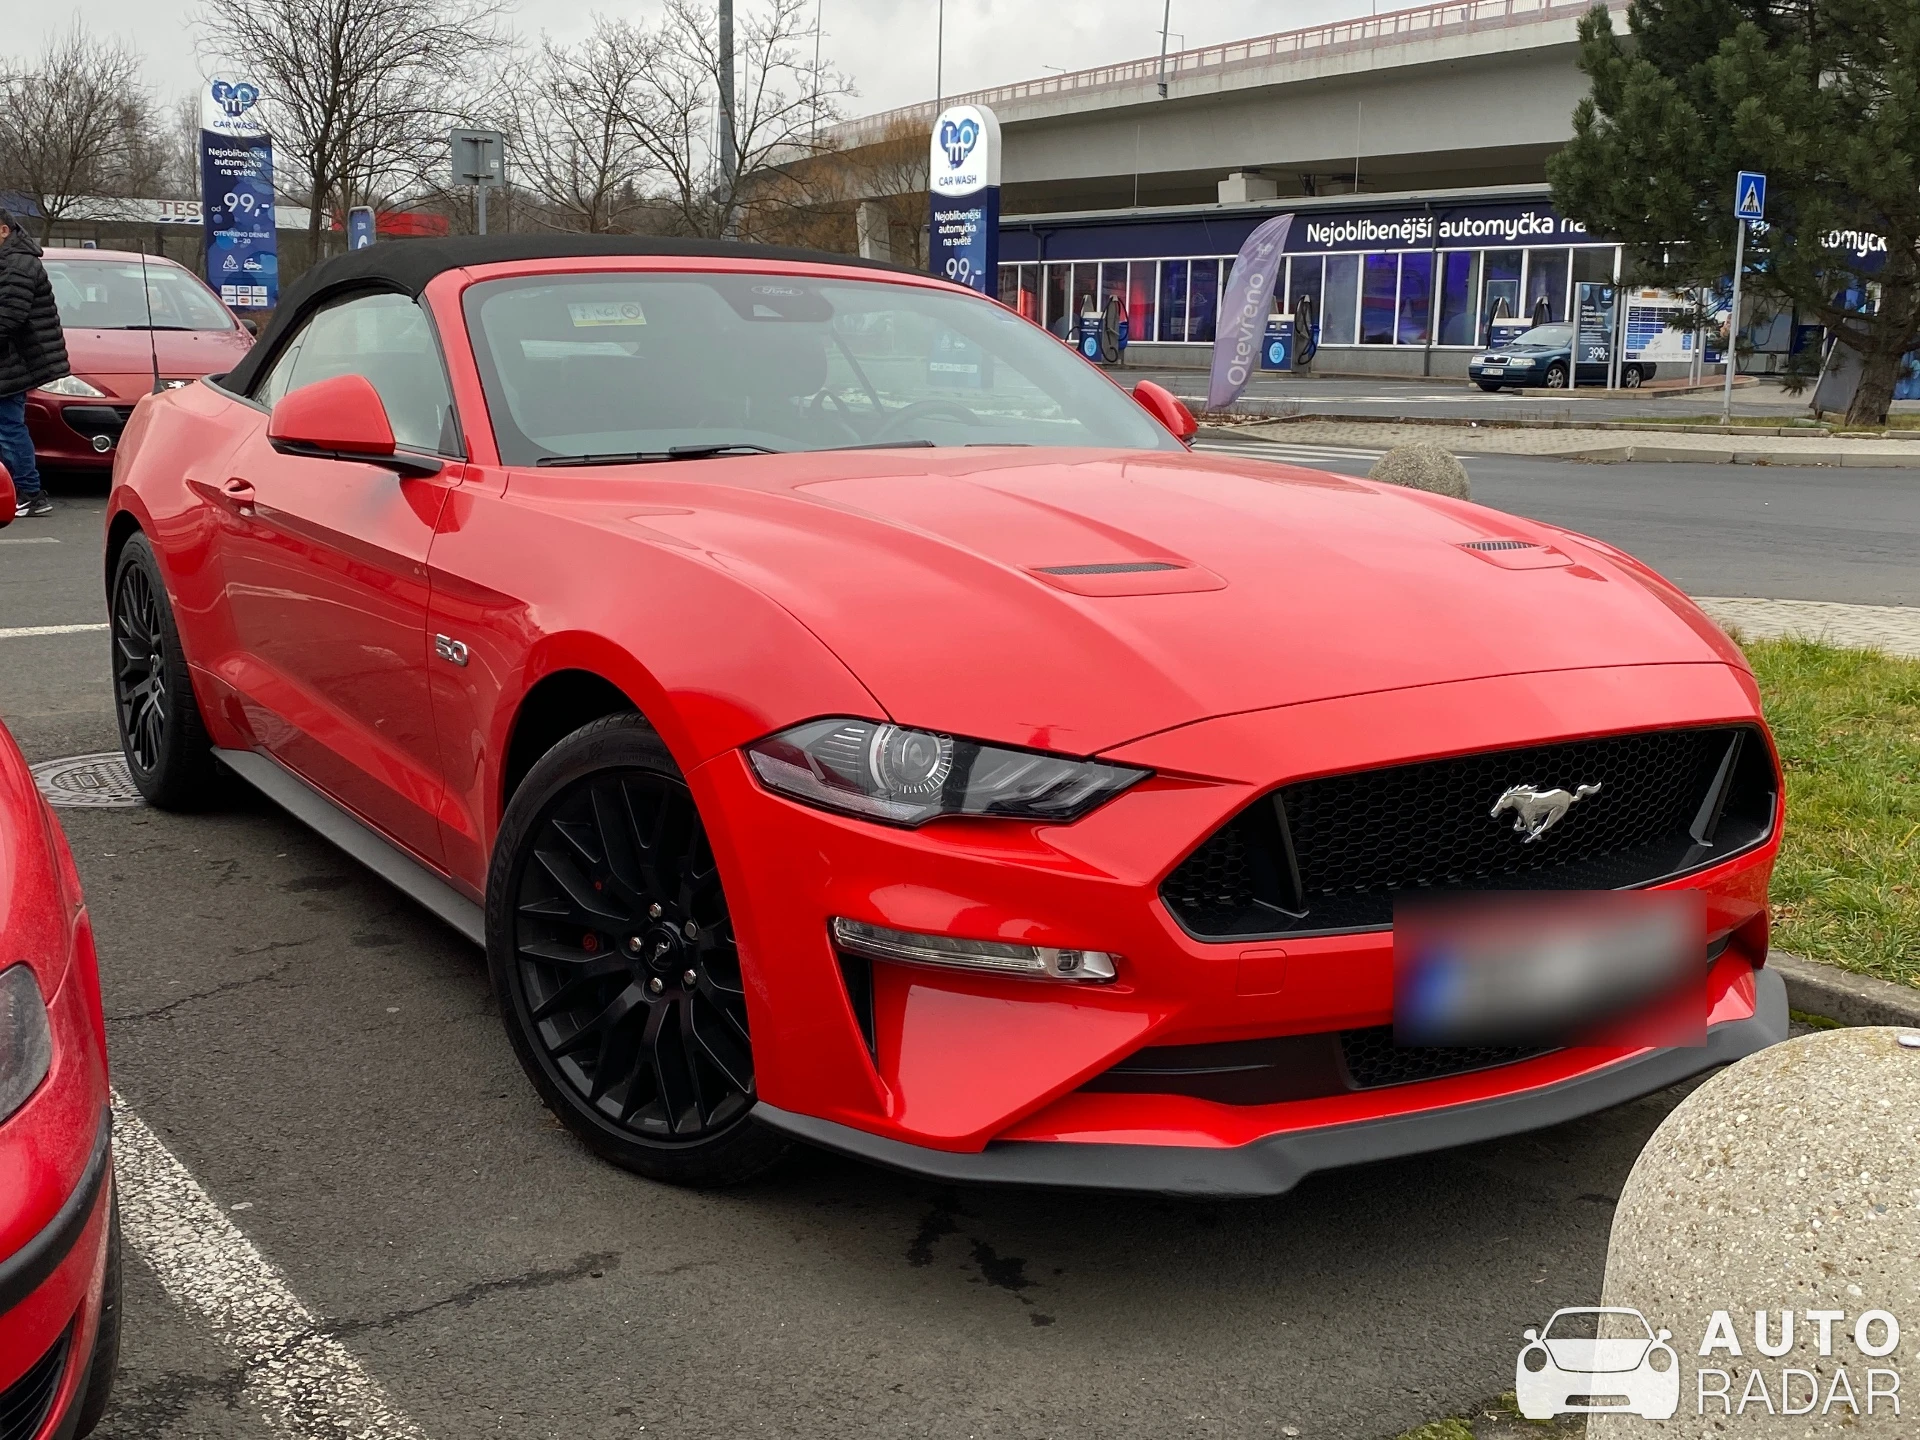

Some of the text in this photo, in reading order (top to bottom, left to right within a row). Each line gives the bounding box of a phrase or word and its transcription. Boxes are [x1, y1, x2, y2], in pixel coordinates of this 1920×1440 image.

[213, 120, 231, 128] CAR
[220, 168, 232, 176] na
[939, 174, 977, 187] CAR WASH
[938, 222, 977, 235] automyčka
[1306, 216, 1434, 247] Nejoblíbenější
[1438, 211, 1554, 241] automyčka
[942, 238, 952, 246] na
[1227, 273, 1264, 386] Otevřeno
